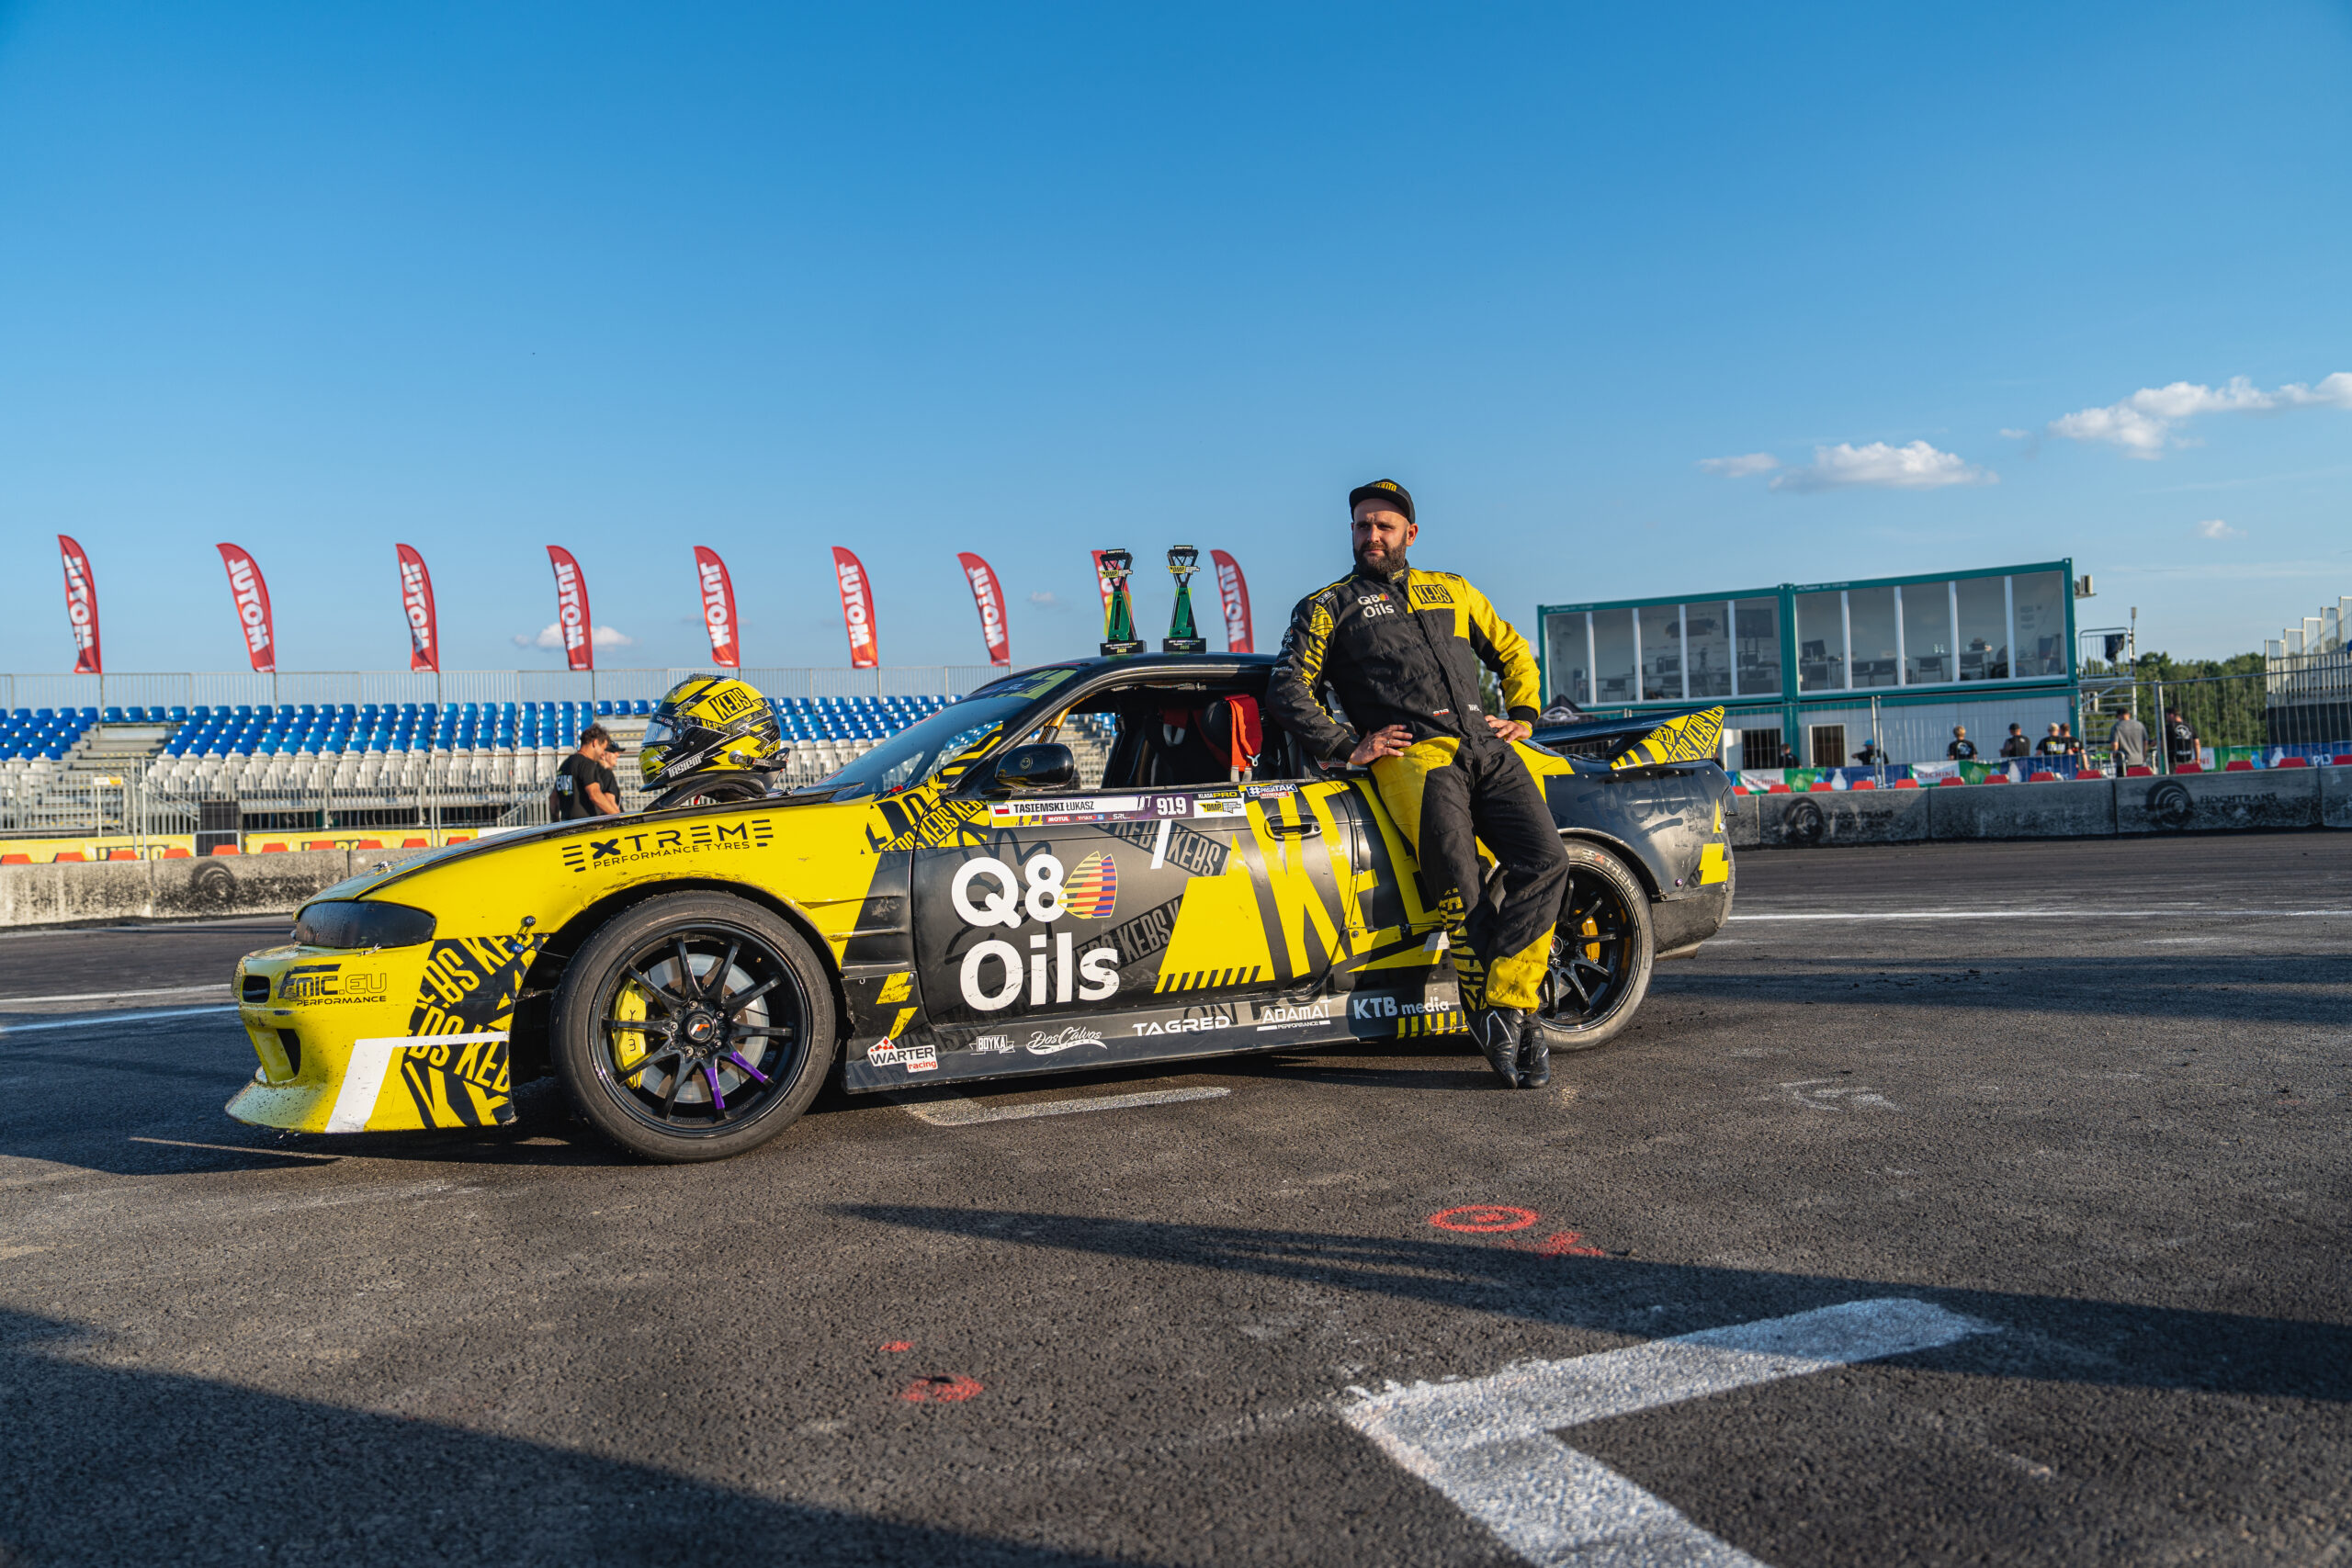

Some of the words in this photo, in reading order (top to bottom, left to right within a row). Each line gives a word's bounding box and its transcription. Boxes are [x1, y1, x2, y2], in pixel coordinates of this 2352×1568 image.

[1358, 593, 1380, 606] Q8
[1413, 584, 1453, 604] KEBS
[1363, 604, 1396, 618] Oils
[709, 688, 752, 720] KEBS
[1014, 802, 1065, 813] TASIEMSKI
[1066, 801, 1094, 811] ŁUKASZ
[1157, 796, 1187, 816] 919
[2199, 792, 2278, 805] HOCHTRANS
[561, 818, 774, 873] EXTREME
[594, 844, 699, 870] PERFORMANCE
[701, 841, 751, 852] TYRES
[952, 853, 1069, 929] Q8
[960, 931, 1120, 1010] Oils
[297, 995, 387, 1007] PERFORMANCE
[1353, 996, 1398, 1020] KTB
[1401, 996, 1450, 1015] media
[1261, 999, 1332, 1024] ADAMAT
[1132, 1015, 1231, 1036] TAGRED
[978, 1036, 1007, 1051] BOYKA
[1027, 1030, 1058, 1051] Dos
[1058, 1026, 1102, 1044] Calvos
[871, 1046, 934, 1065] WARTER
[909, 1060, 937, 1071] racing
